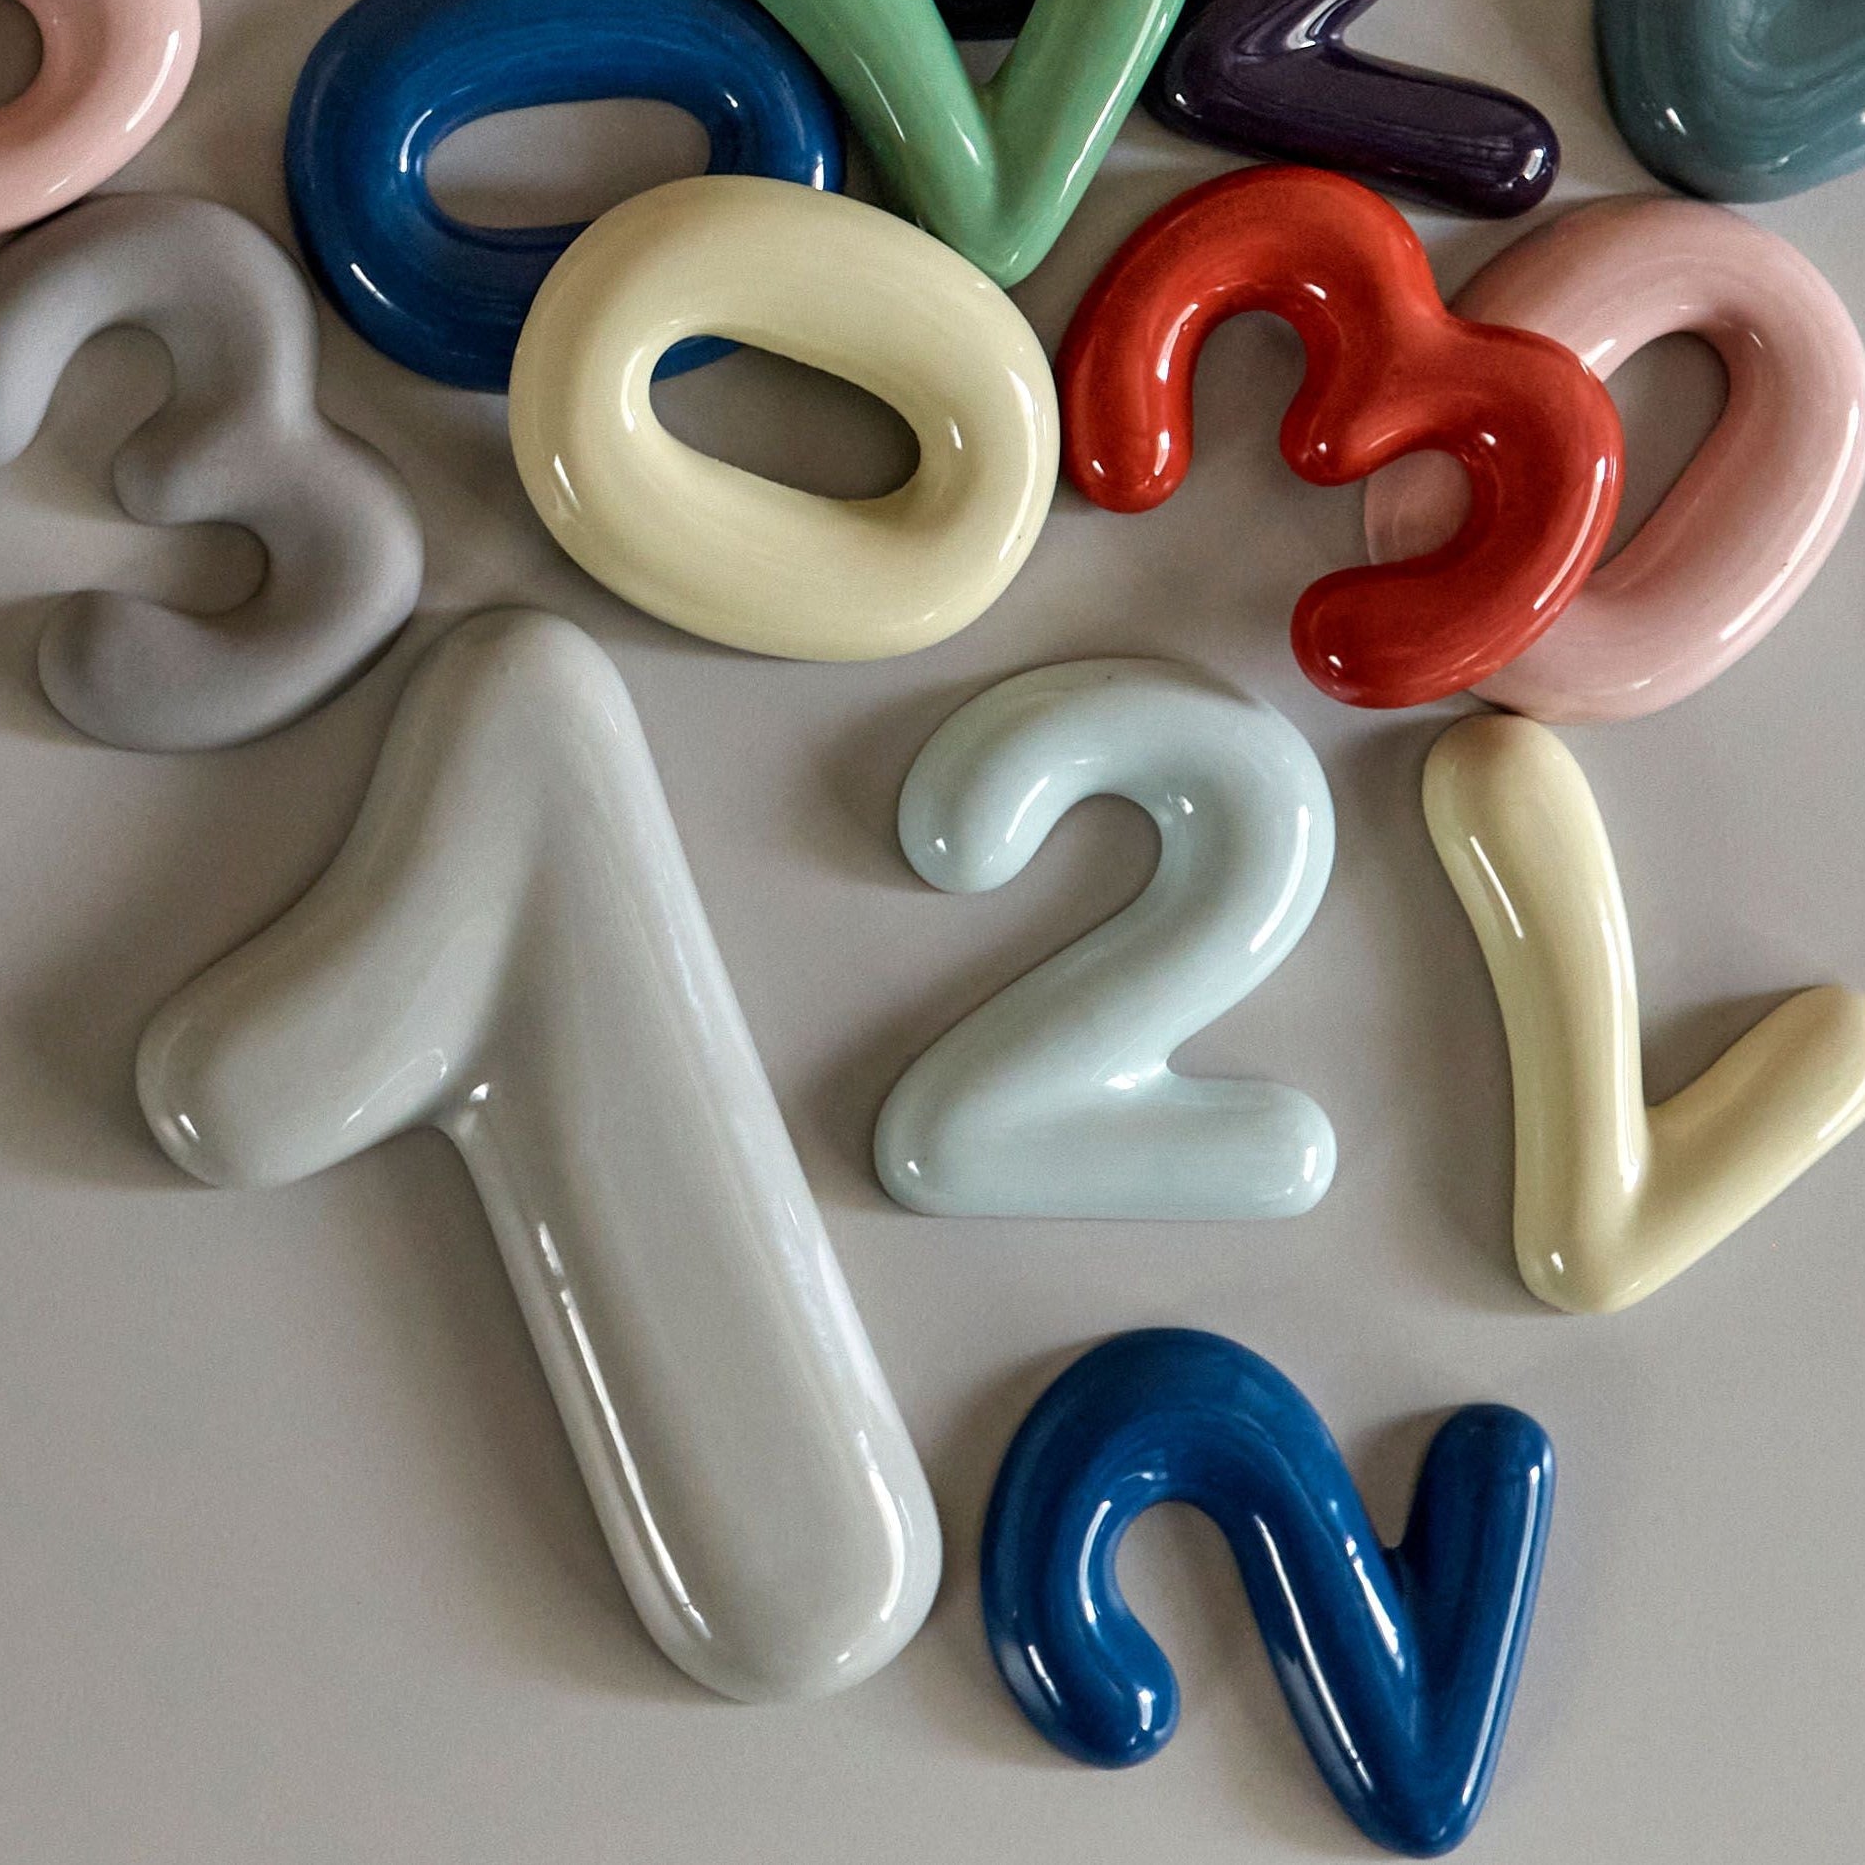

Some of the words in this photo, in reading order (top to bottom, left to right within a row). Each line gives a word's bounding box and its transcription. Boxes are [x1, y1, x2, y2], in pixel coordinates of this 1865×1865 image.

[1061, 165, 1625, 710] 3
[137, 607, 943, 1703] 1
[875, 657, 1338, 1220] 2
[981, 1327, 1557, 1857] 2
